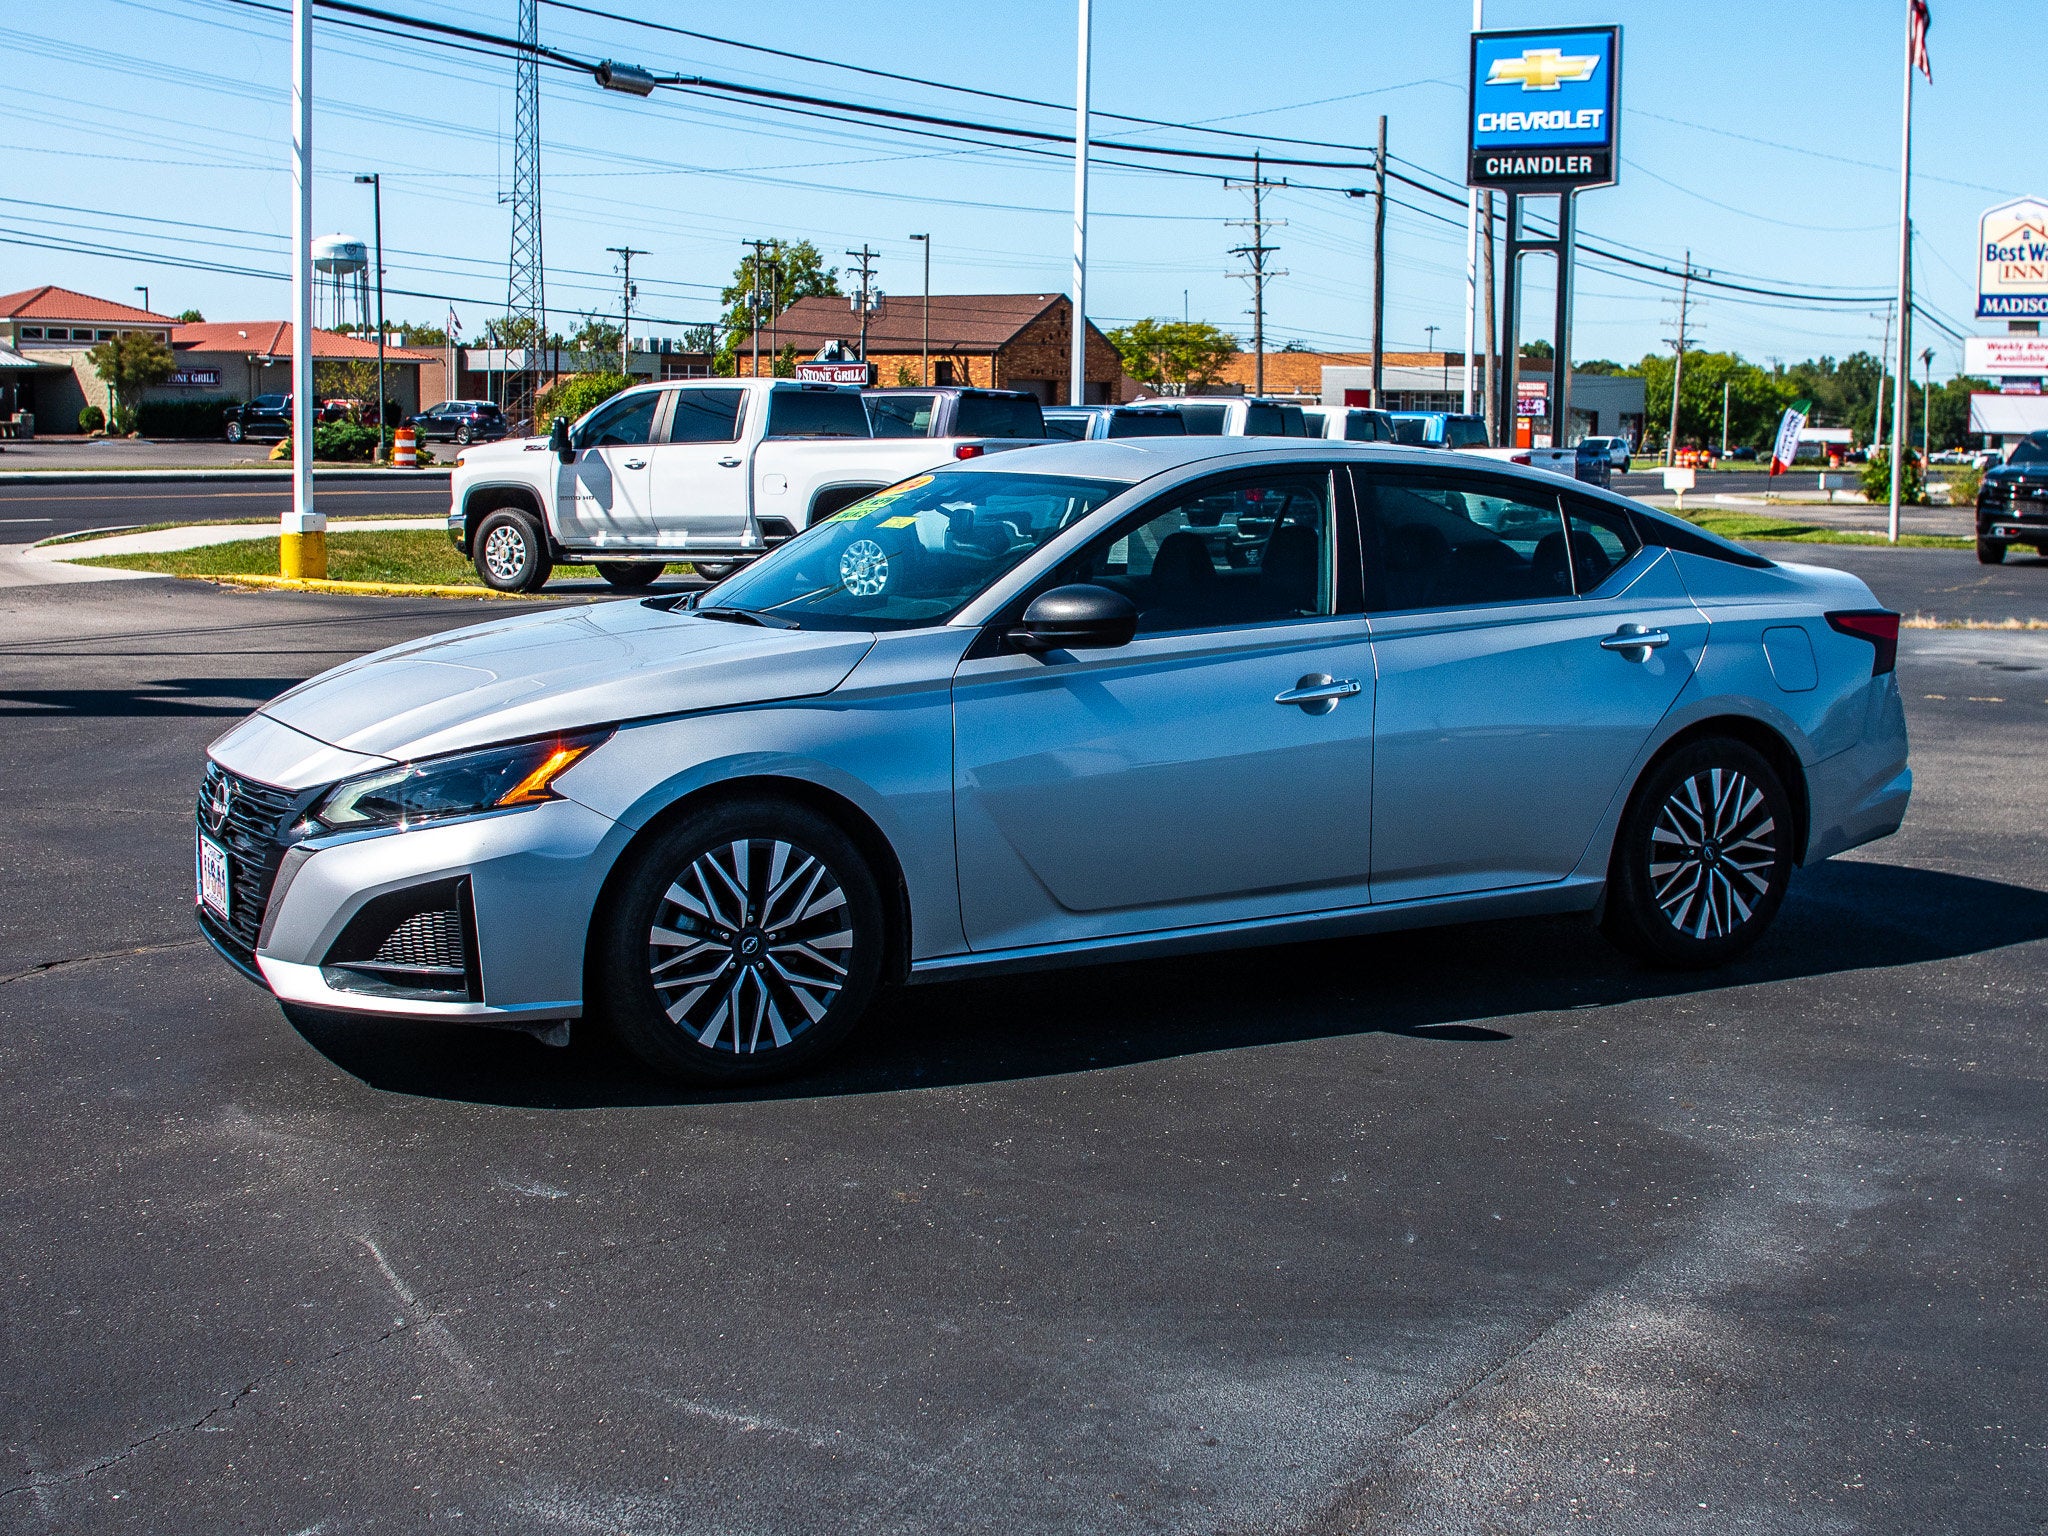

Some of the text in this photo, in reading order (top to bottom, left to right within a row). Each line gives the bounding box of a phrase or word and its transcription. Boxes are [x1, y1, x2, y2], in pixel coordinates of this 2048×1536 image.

[1478, 109, 1603, 131] CHEVROLET
[1486, 156, 1592, 174] CHANDLER
[1986, 243, 2025, 262] Best
[2004, 264, 2044, 278] INN
[1983, 298, 2048, 313] MADISO
[1987, 343, 2022, 352] Weekly
[1996, 354, 2045, 362] Available
[167, 372, 215, 383] TONE GRILL
[802, 368, 861, 382] STONE GRILL
